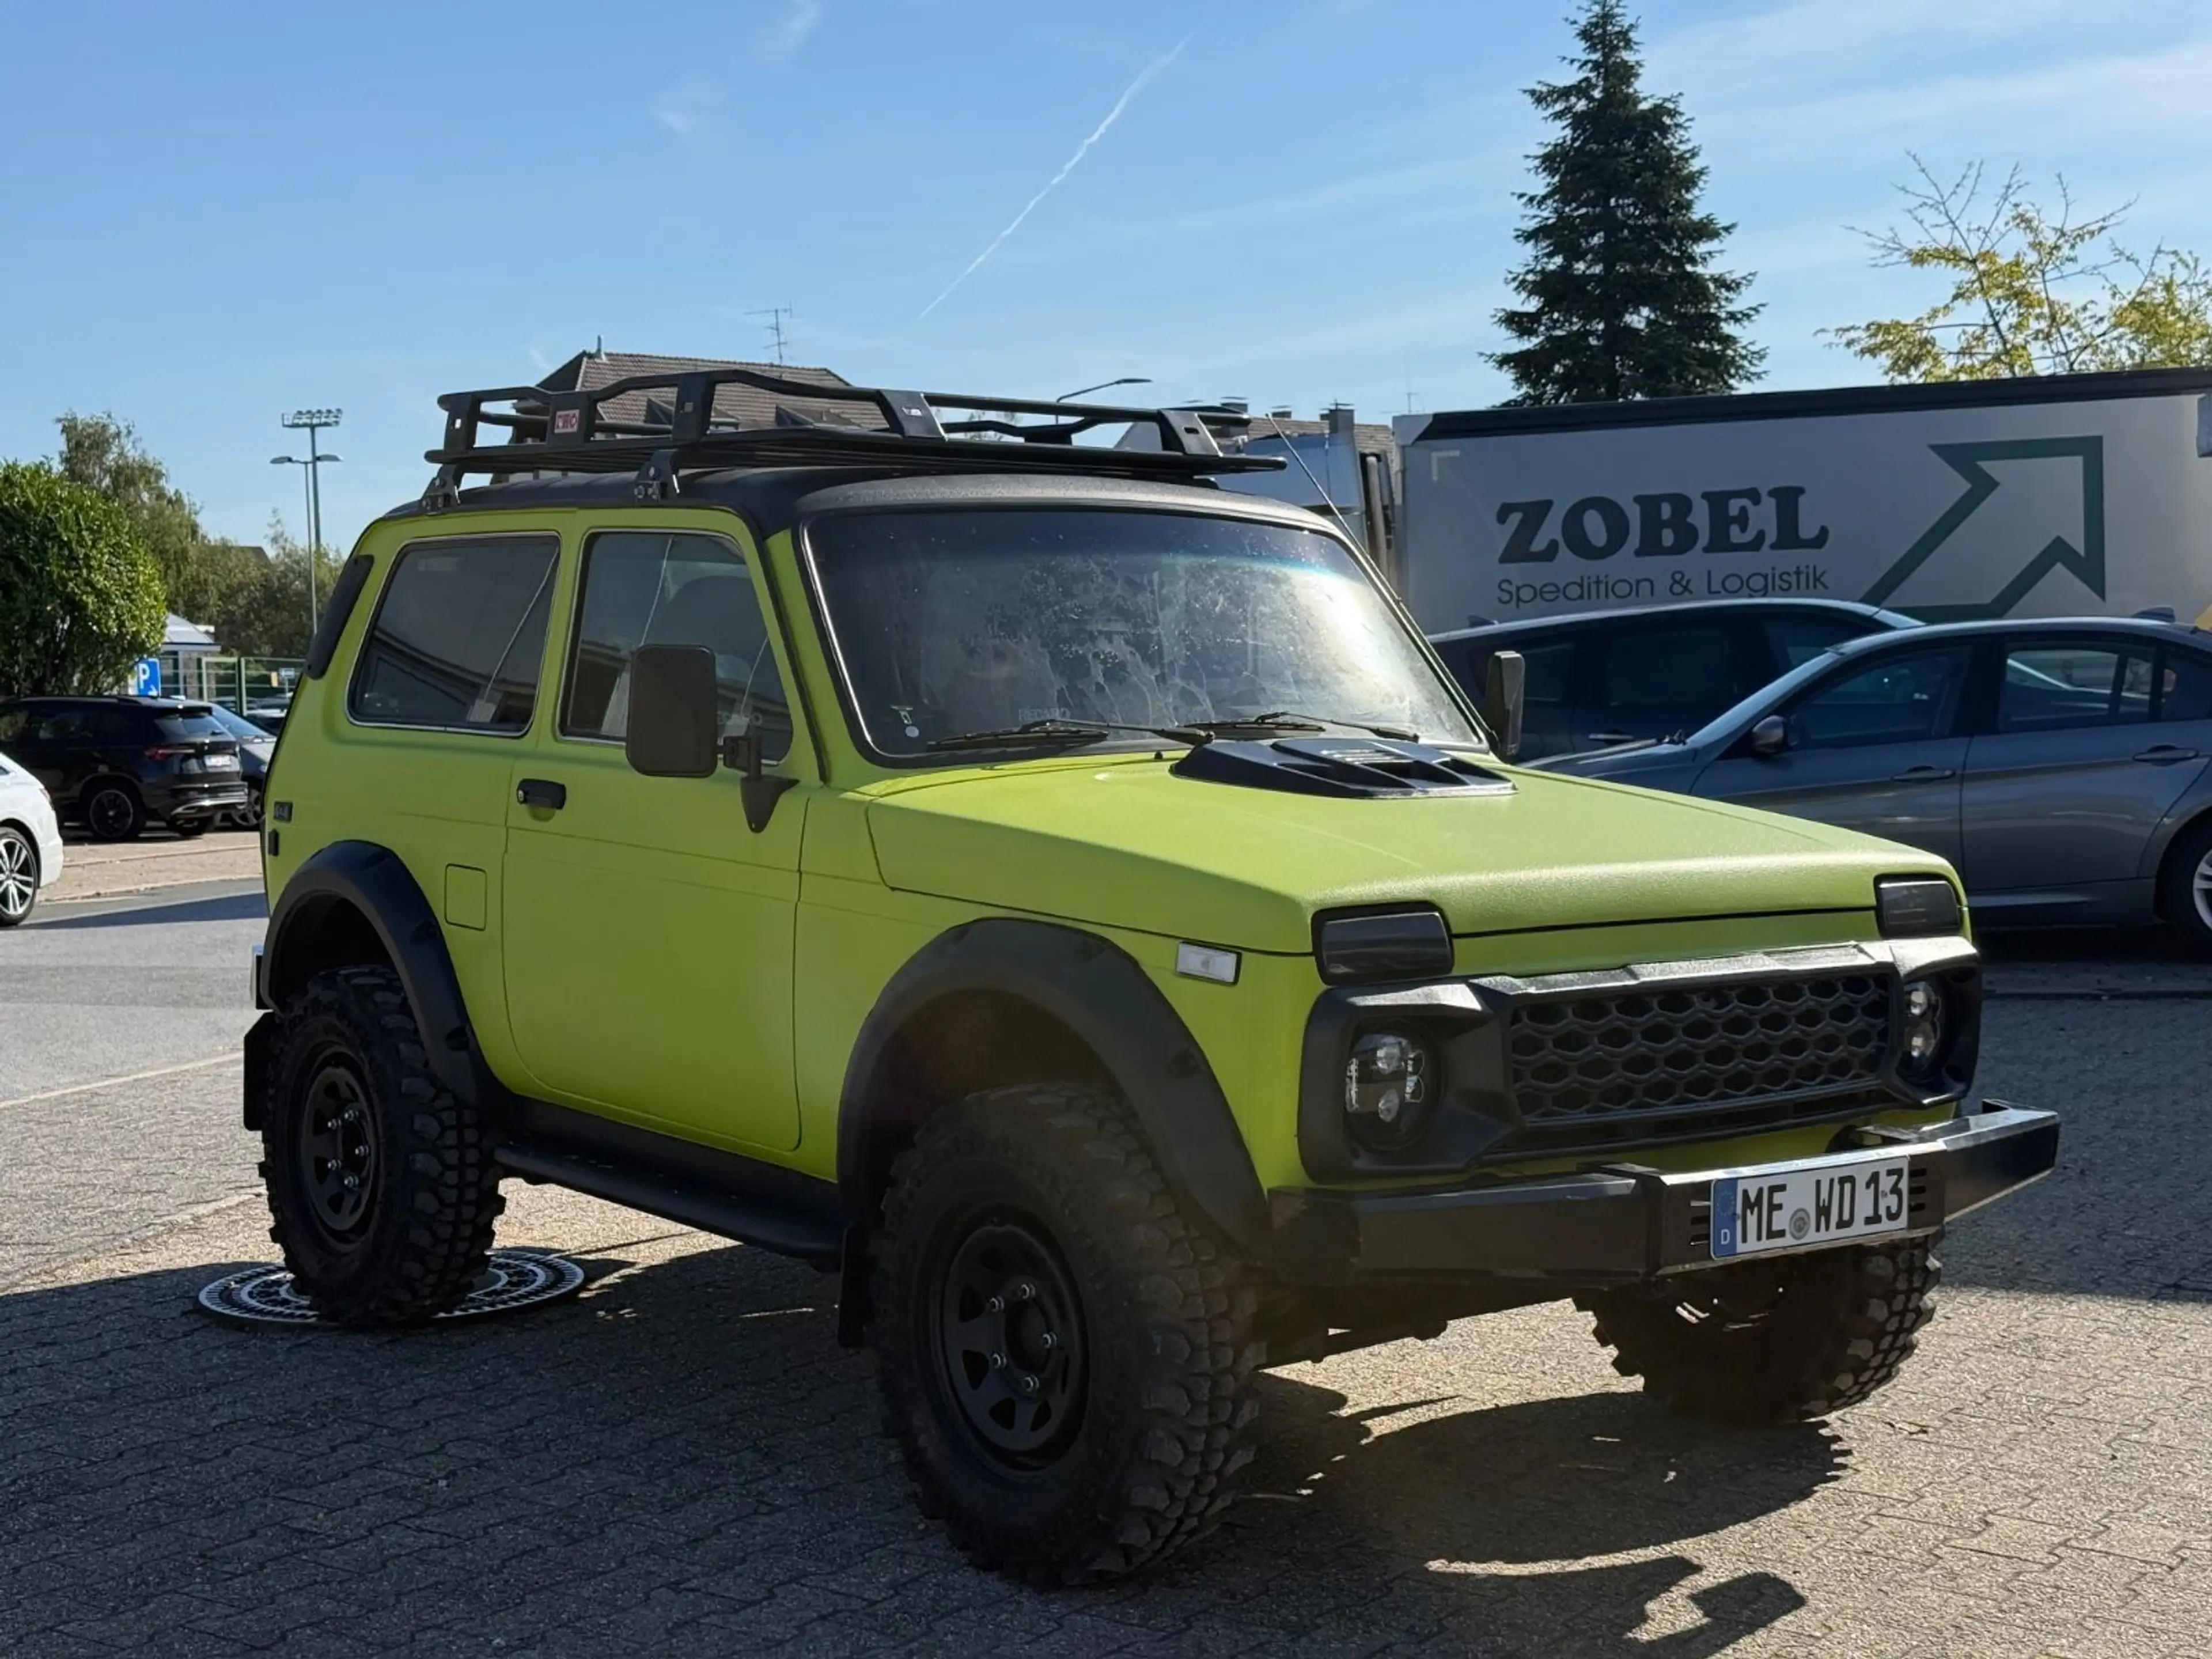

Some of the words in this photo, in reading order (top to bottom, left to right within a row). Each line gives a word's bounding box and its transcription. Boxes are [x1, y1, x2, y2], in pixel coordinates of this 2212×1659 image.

[1496, 486, 1830, 564] ZOBEL
[1497, 574, 1654, 609] Spedition
[1669, 570, 1694, 597] &
[1707, 565, 1830, 598] Logistik
[139, 663, 150, 690] P
[1741, 1183, 1787, 1244] ME
[1815, 1175, 1856, 1233] WD
[1863, 1168, 1904, 1225] 13
[1721, 1228, 1730, 1245] D
